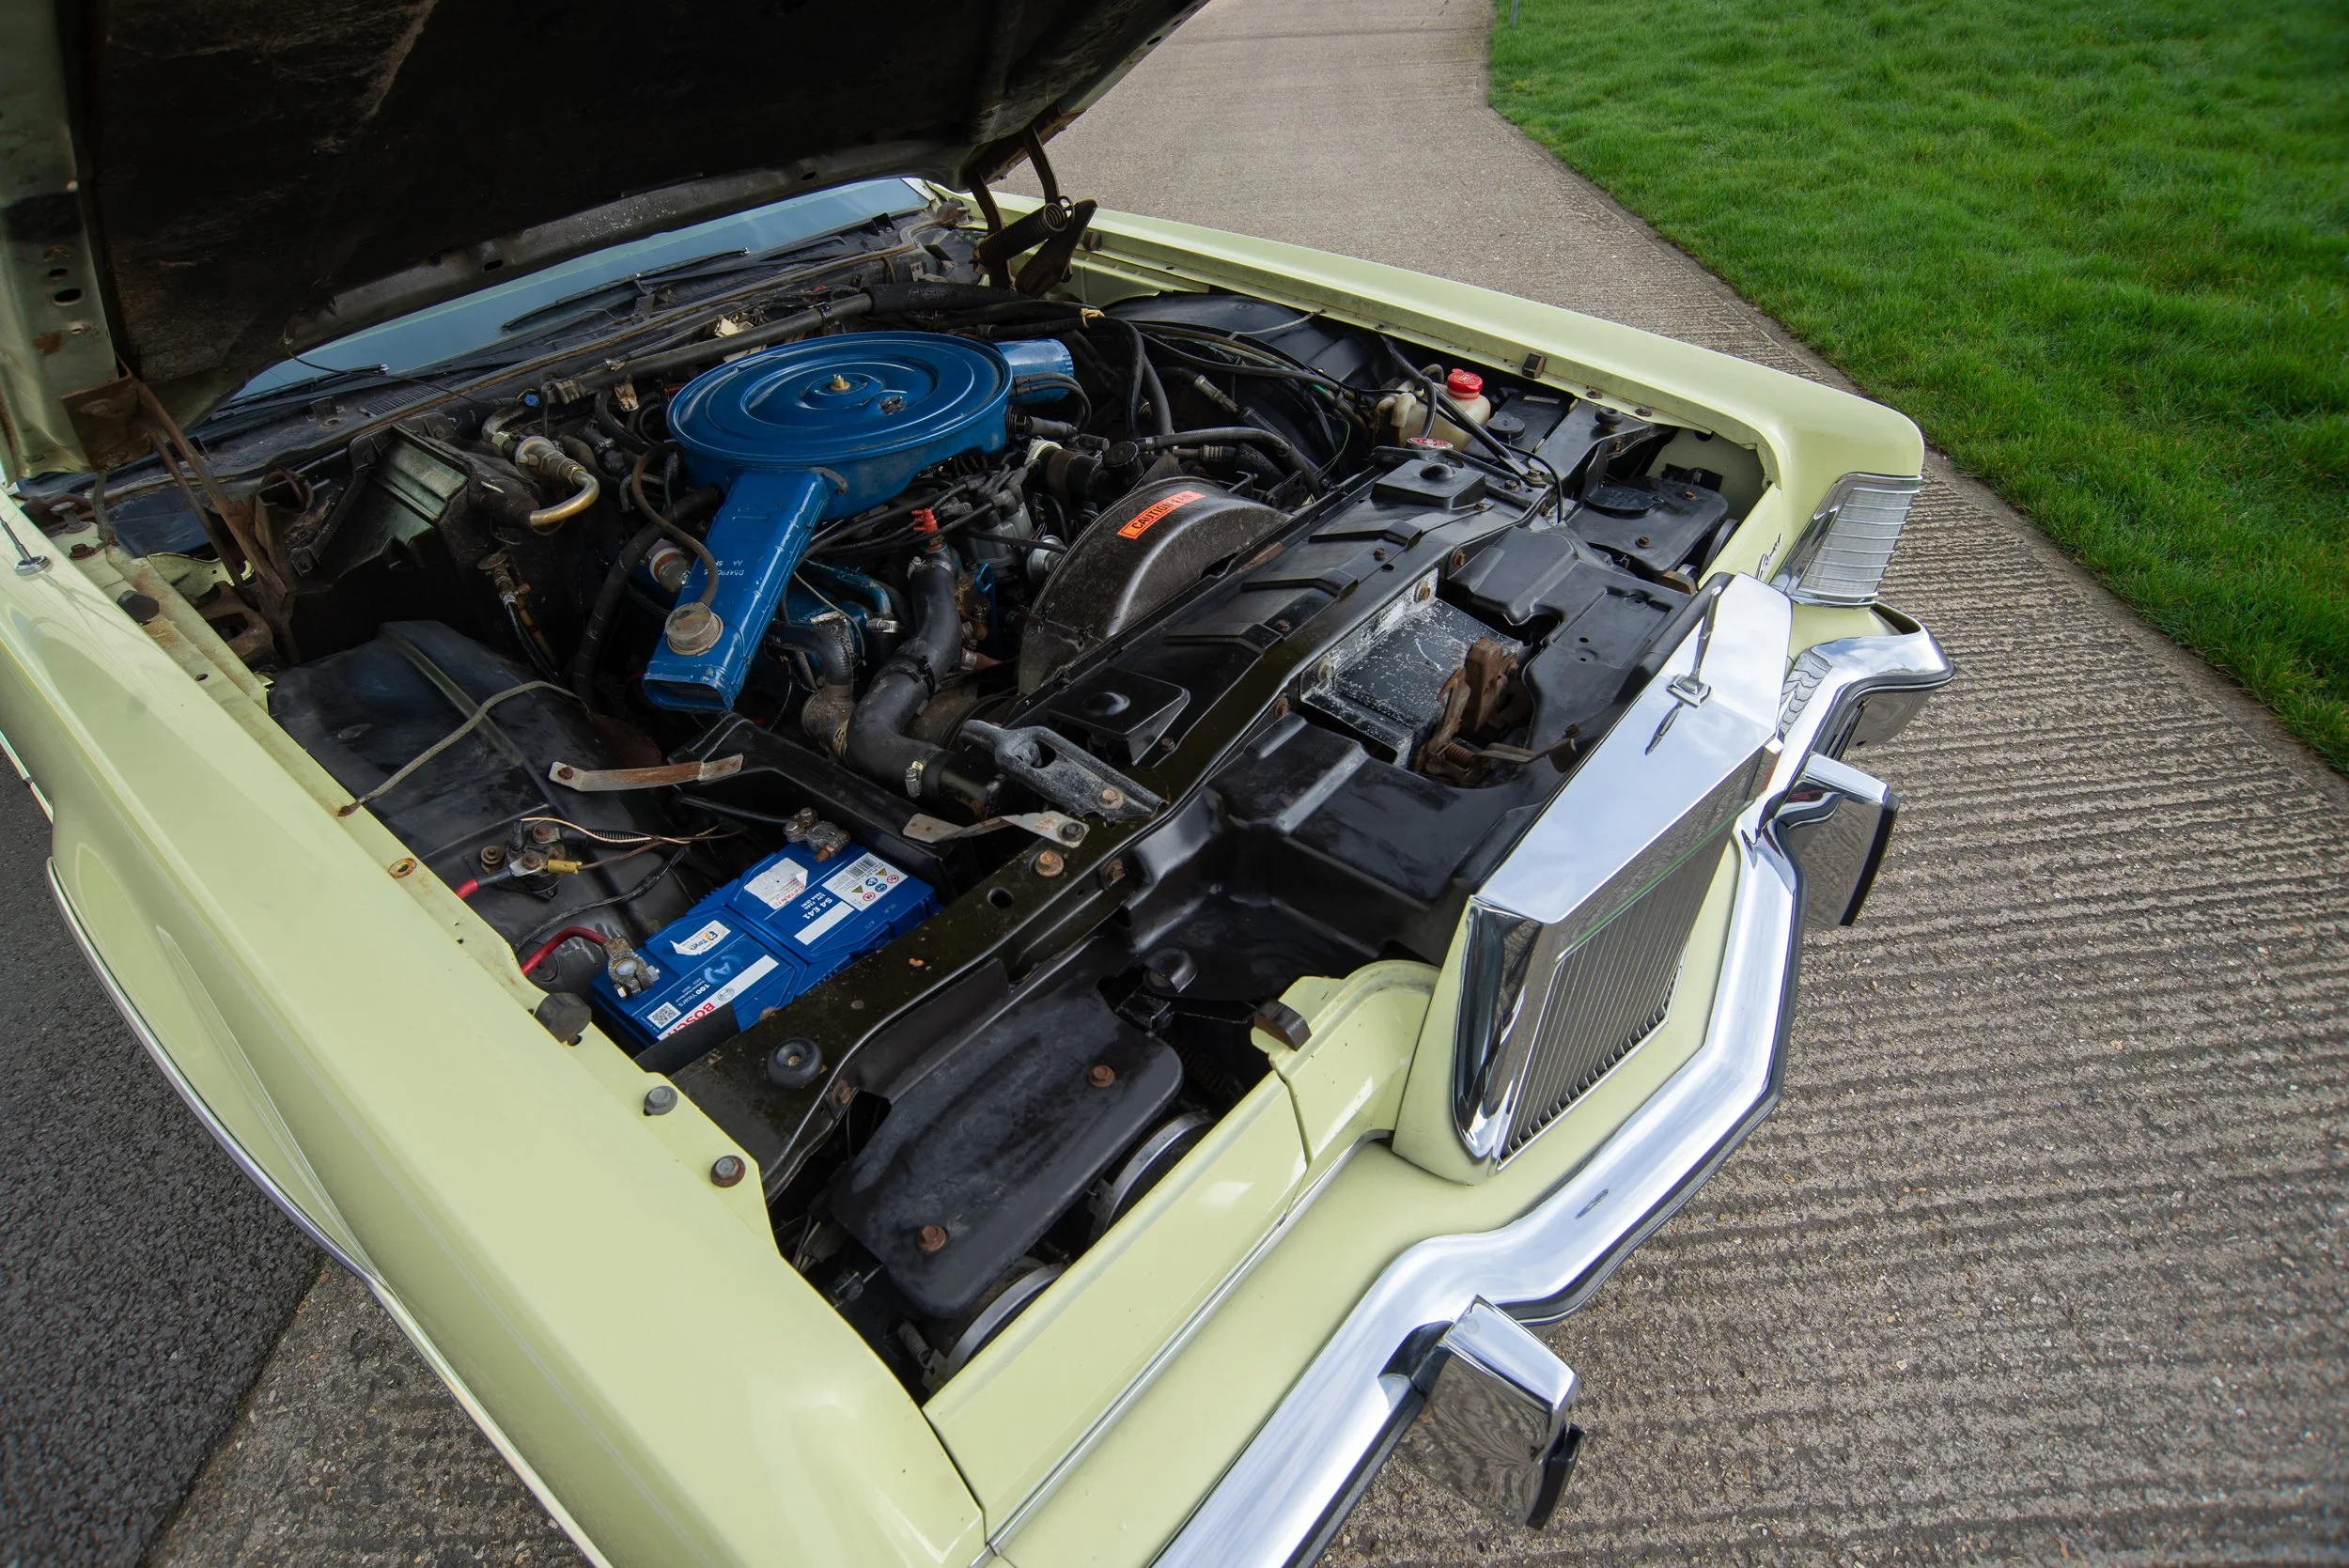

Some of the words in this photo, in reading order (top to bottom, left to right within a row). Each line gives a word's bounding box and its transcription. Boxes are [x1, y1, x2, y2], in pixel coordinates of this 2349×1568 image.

[1131, 500, 1174, 529] CAUTION
[819, 897, 833, 908] S4
[802, 906, 821, 920] E41
[691, 939, 708, 951] Tayn
[695, 984, 710, 996] 100
[677, 993, 696, 1007] Years
